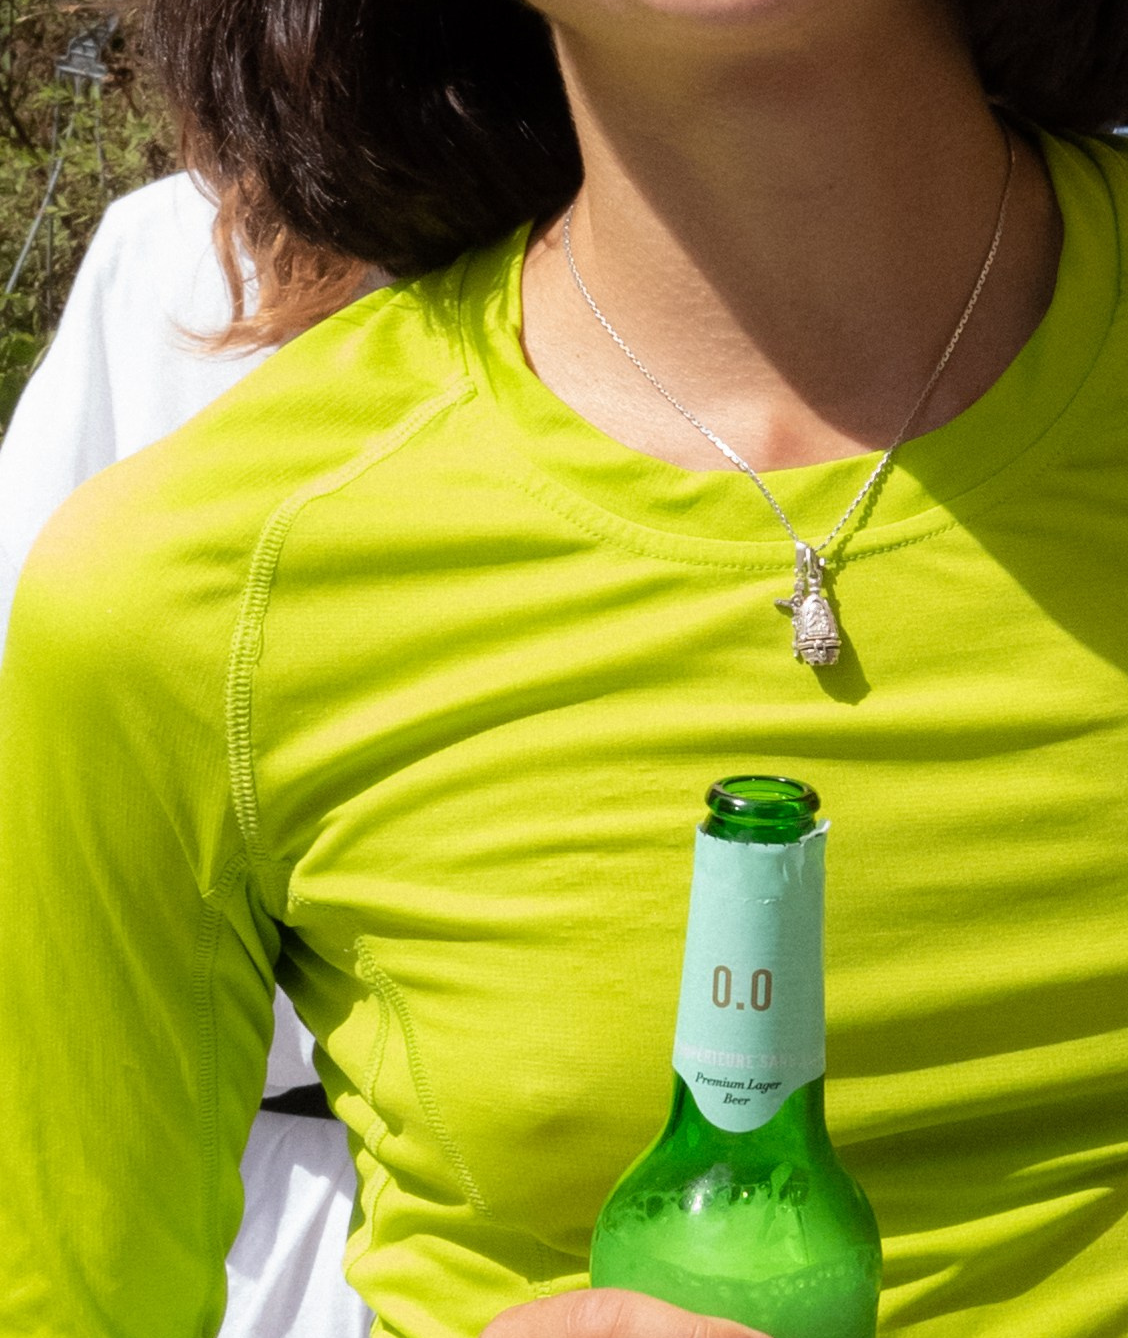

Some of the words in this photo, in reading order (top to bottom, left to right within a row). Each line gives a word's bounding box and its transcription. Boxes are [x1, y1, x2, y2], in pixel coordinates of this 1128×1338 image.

[712, 965, 772, 1011] 0.0
[695, 1071, 745, 1090] Premium
[747, 1078, 782, 1094] Lager
[722, 1092, 751, 1105] Beer
